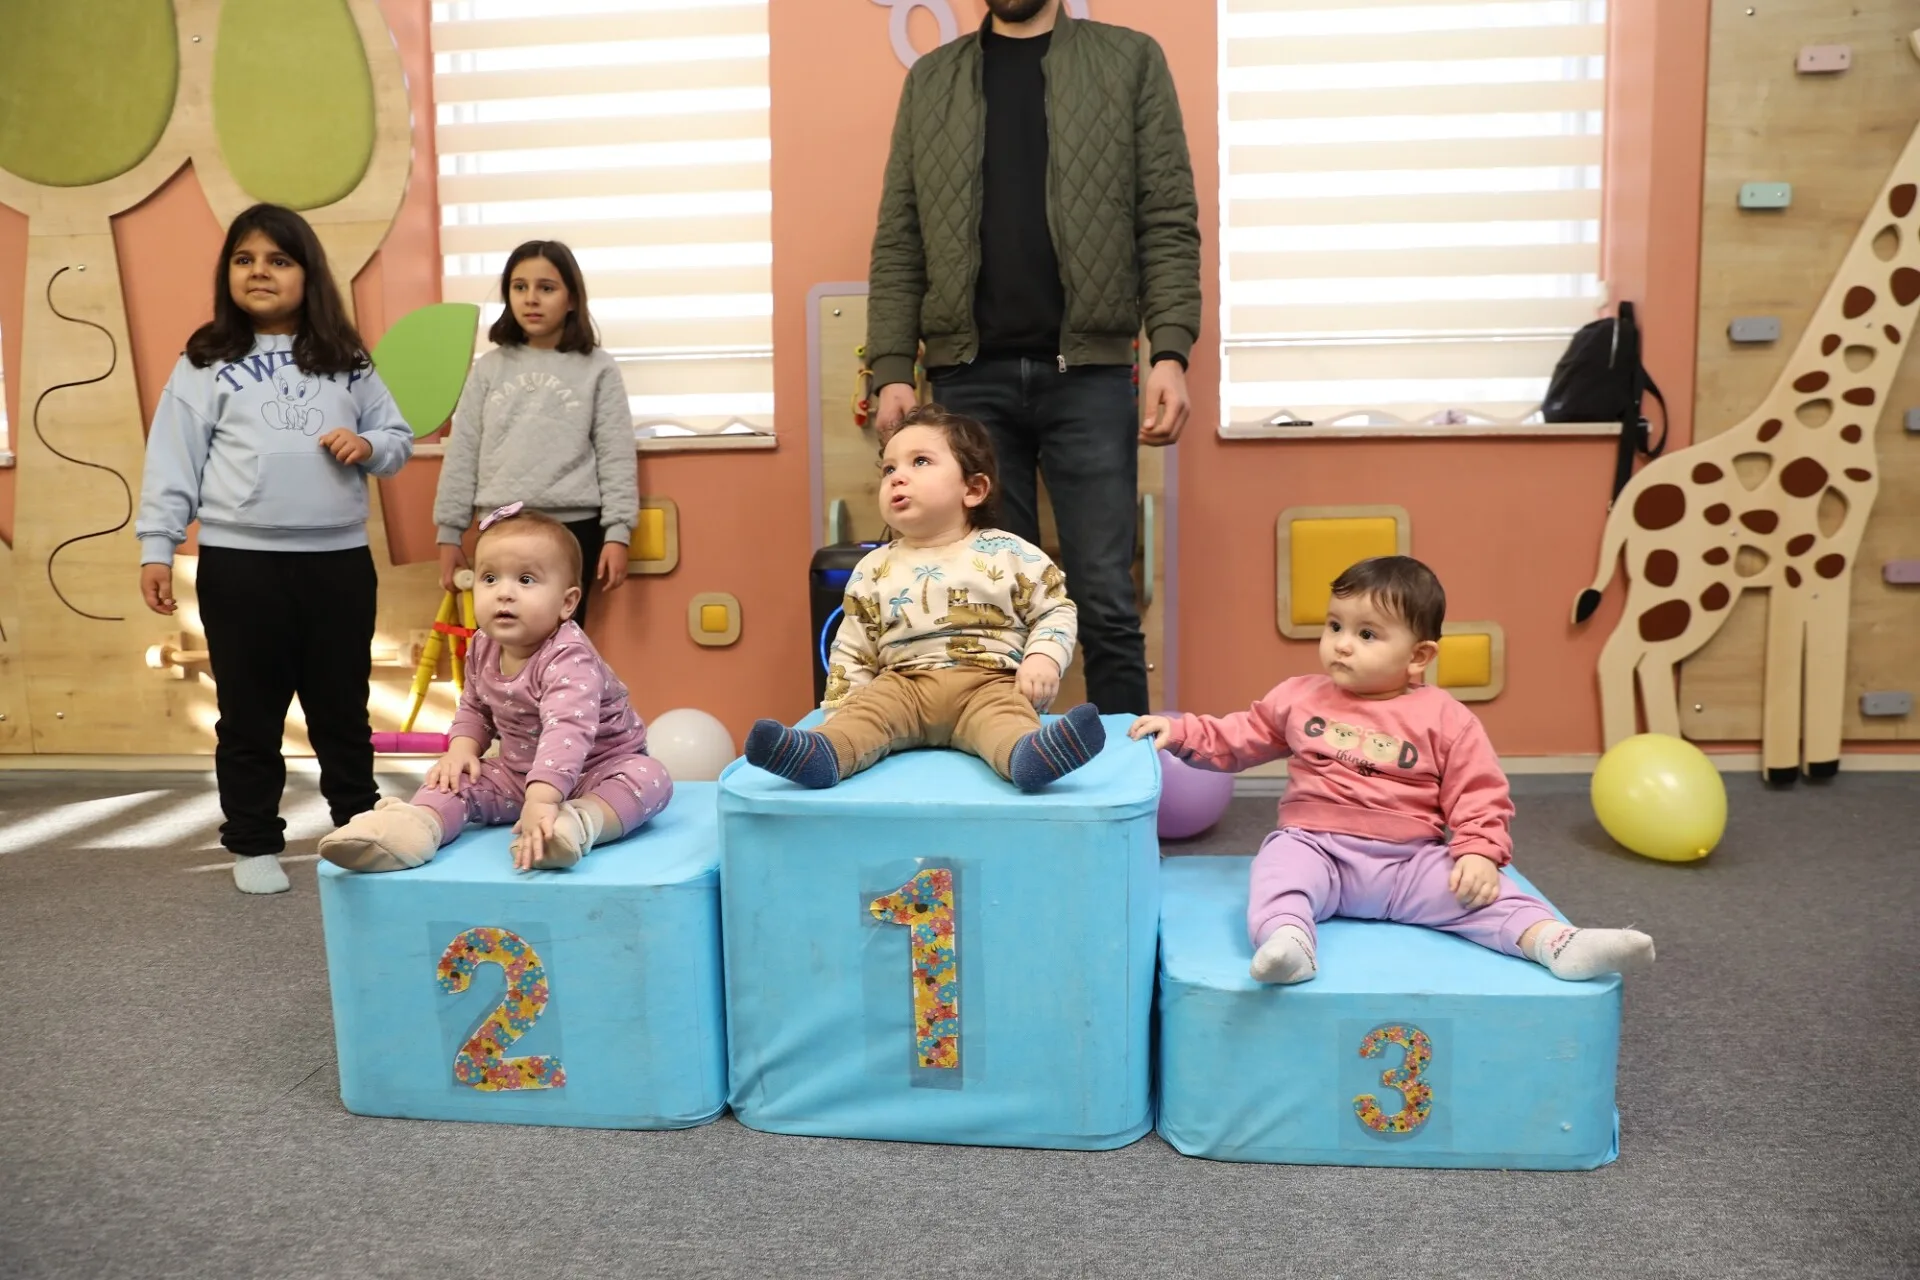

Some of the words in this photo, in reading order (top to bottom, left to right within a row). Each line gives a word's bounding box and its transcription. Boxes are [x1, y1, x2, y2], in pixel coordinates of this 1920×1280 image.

[490, 371, 582, 413] NATURAL
[436, 926, 566, 1092] 2
[869, 868, 959, 1069] 1
[1352, 1025, 1433, 1133] 3
